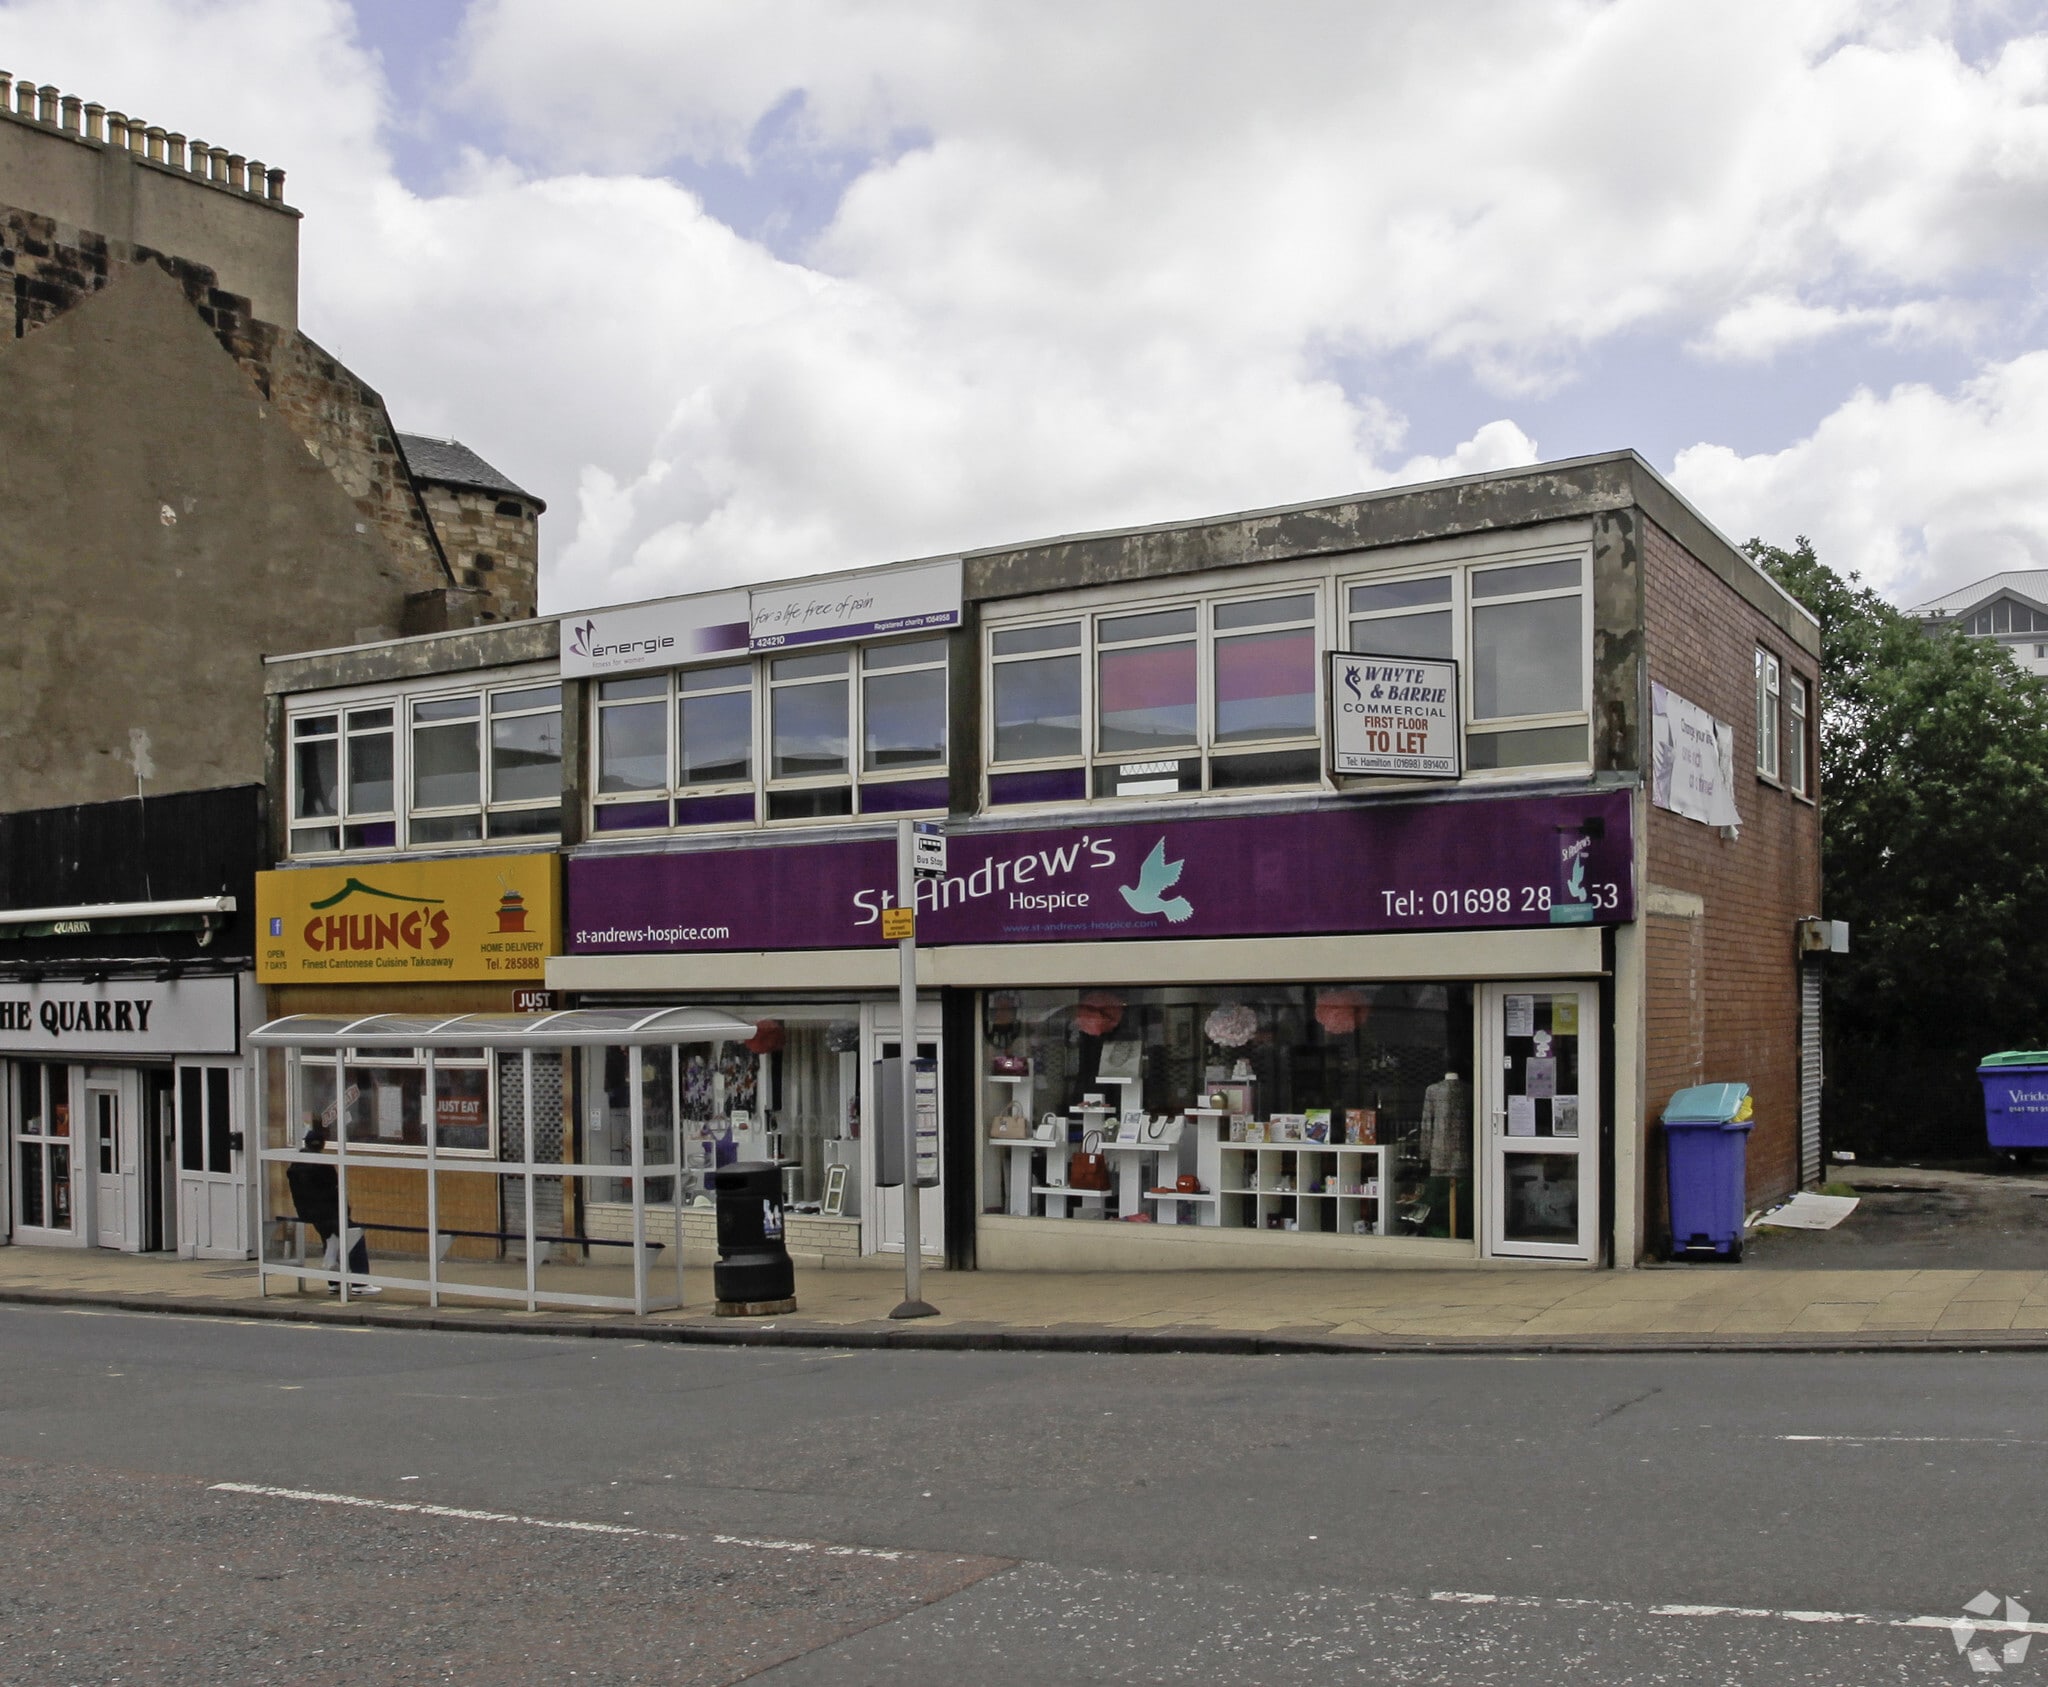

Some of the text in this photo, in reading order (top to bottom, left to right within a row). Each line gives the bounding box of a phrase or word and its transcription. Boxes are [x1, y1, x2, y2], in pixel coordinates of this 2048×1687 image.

[751, 608, 774, 631] for
[774, 610, 781, 621] a
[803, 600, 833, 623] free
[835, 595, 852, 618] of
[849, 592, 874, 619] pain
[905, 616, 924, 628] charity
[756, 635, 786, 648] 424210
[1365, 666, 1425, 684] WHYTE
[1370, 683, 1447, 703] & BARRIE
[1343, 703, 1447, 718] COMMERCIAL
[1364, 715, 1429, 731] FIRST FLOOR
[1366, 730, 1428, 755] TO LET
[1360, 757, 1392, 768] Hamilton
[1423, 759, 1449, 770] 891400
[917, 854, 944, 867] Bus Stop
[853, 835, 1116, 926] St Andrew's
[1009, 891, 1090, 913] Hospice
[1381, 882, 1618, 916] Tel: 01698 2853
[54, 921, 92, 933] QUARRY
[304, 906, 451, 953] CHUNG'S
[1003, 918, 1159, 933] www.st-andrews-hospice.com
[576, 925, 730, 944] st-andrews-hospice.com
[267, 949, 286, 959] OPEN
[481, 941, 544, 953] HOME DELIVERY
[265, 960, 288, 970] 7 DAYS
[302, 956, 455, 969] Finest Cantonese Cuisine Takeaway
[486, 957, 540, 970] Tel. 285888
[519, 992, 551, 1008] JUST
[0, 1000, 153, 1037] HE QUARRY
[437, 1100, 480, 1114] JUST EAT
